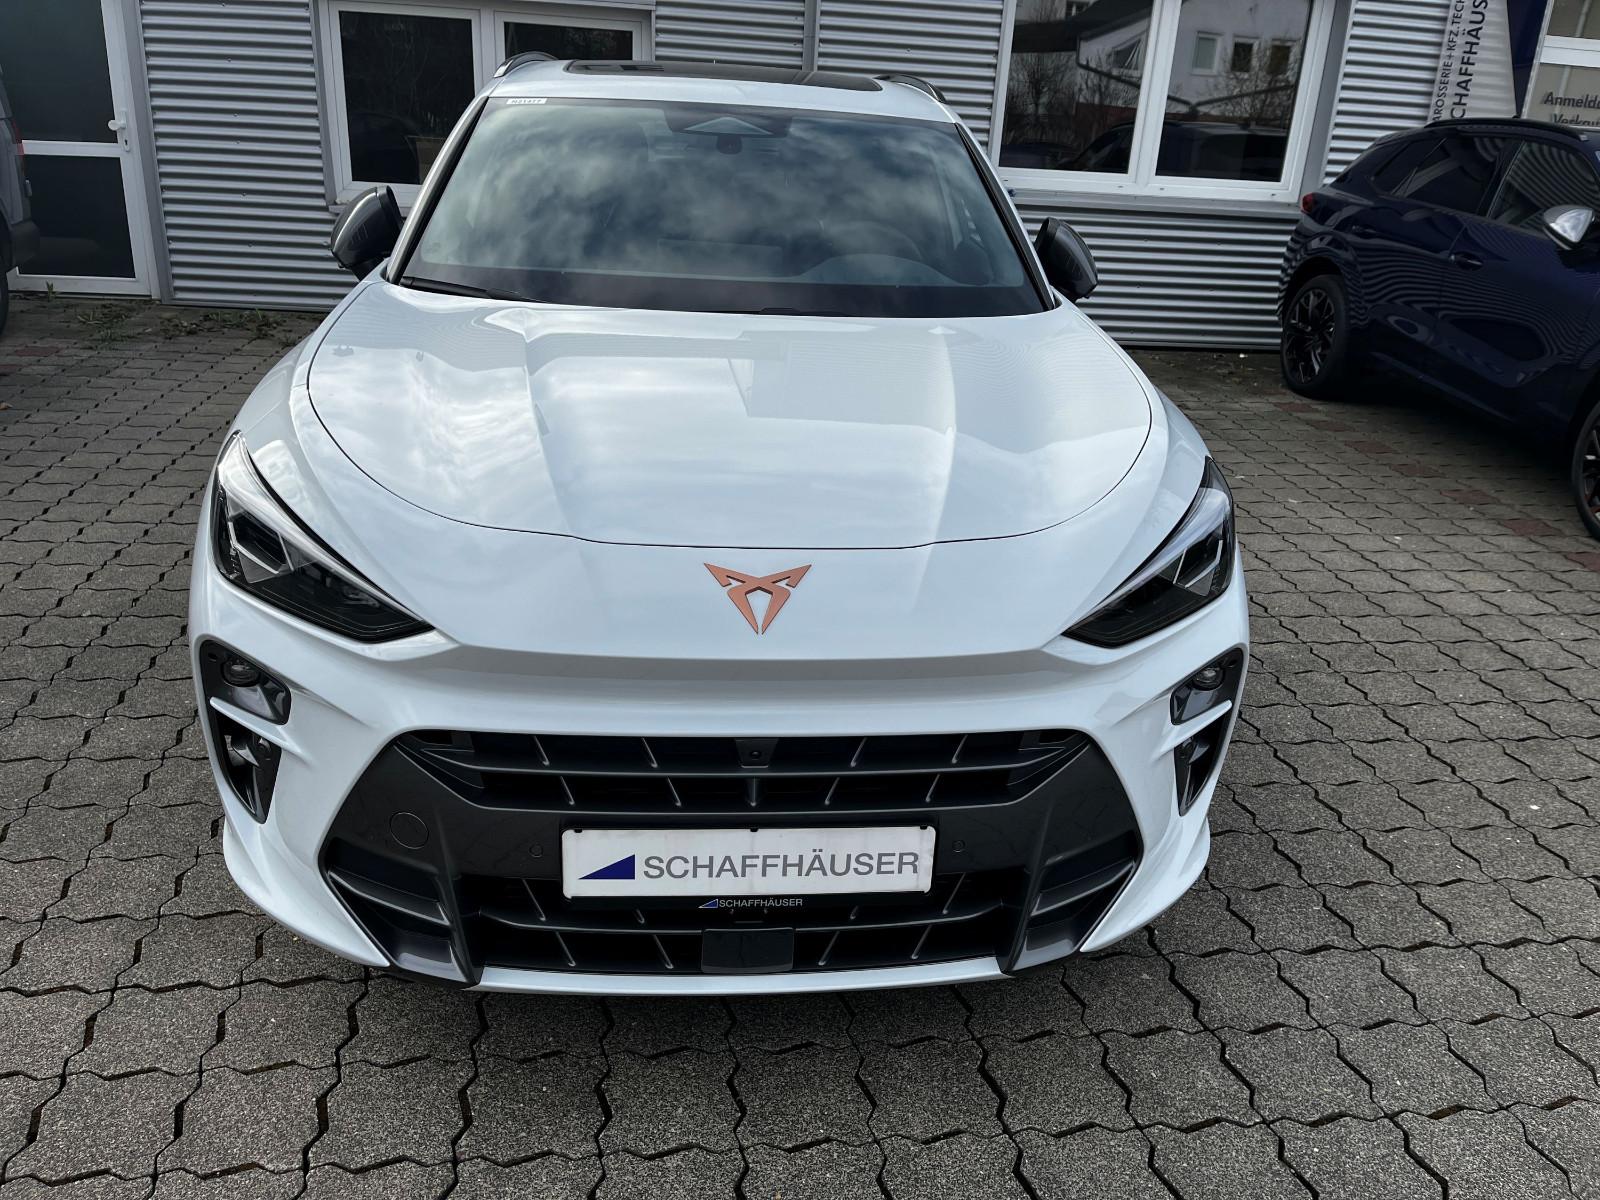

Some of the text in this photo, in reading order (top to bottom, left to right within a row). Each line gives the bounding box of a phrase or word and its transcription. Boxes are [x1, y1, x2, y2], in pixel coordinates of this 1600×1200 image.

[1450, 0, 1488, 119] CHAFFHÄUS
[643, 848, 919, 879] SCHAFFHÄUSER
[719, 897, 803, 908] SCHAFFHÄUSER
